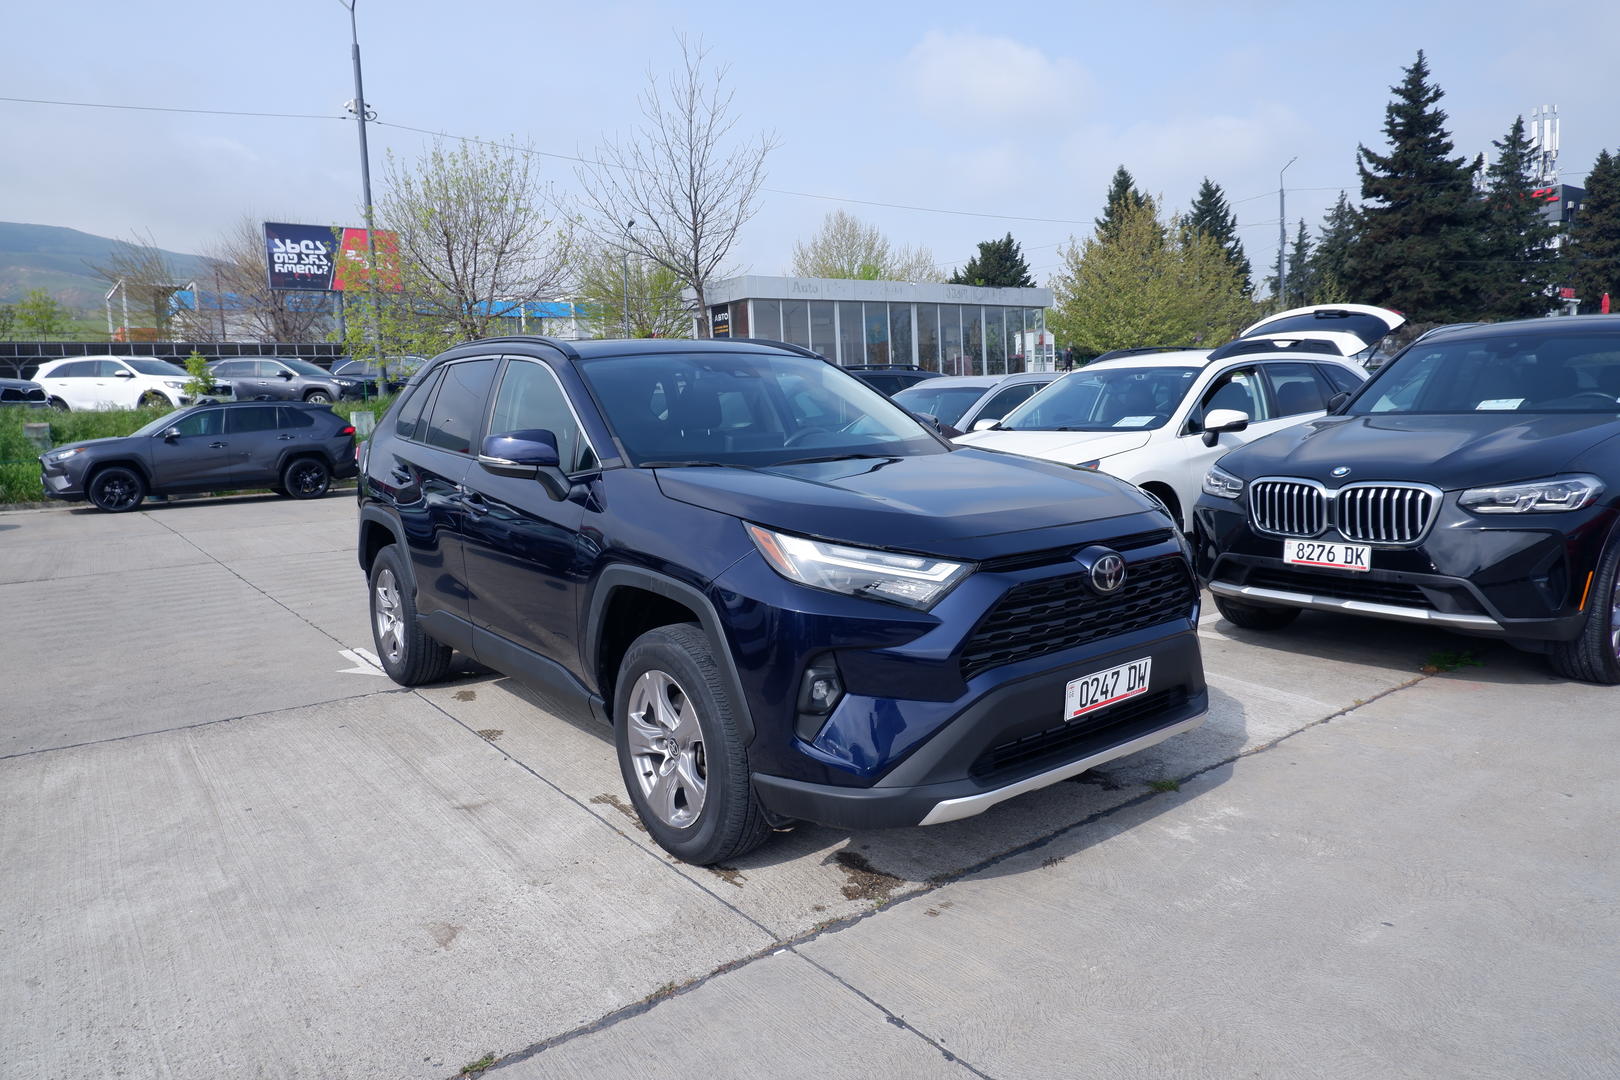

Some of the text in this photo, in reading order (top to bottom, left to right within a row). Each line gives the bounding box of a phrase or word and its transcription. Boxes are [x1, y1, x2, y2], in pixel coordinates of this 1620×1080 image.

[1296, 543, 1365, 566] 8276 DK
[1080, 662, 1148, 708] 0247 DW
